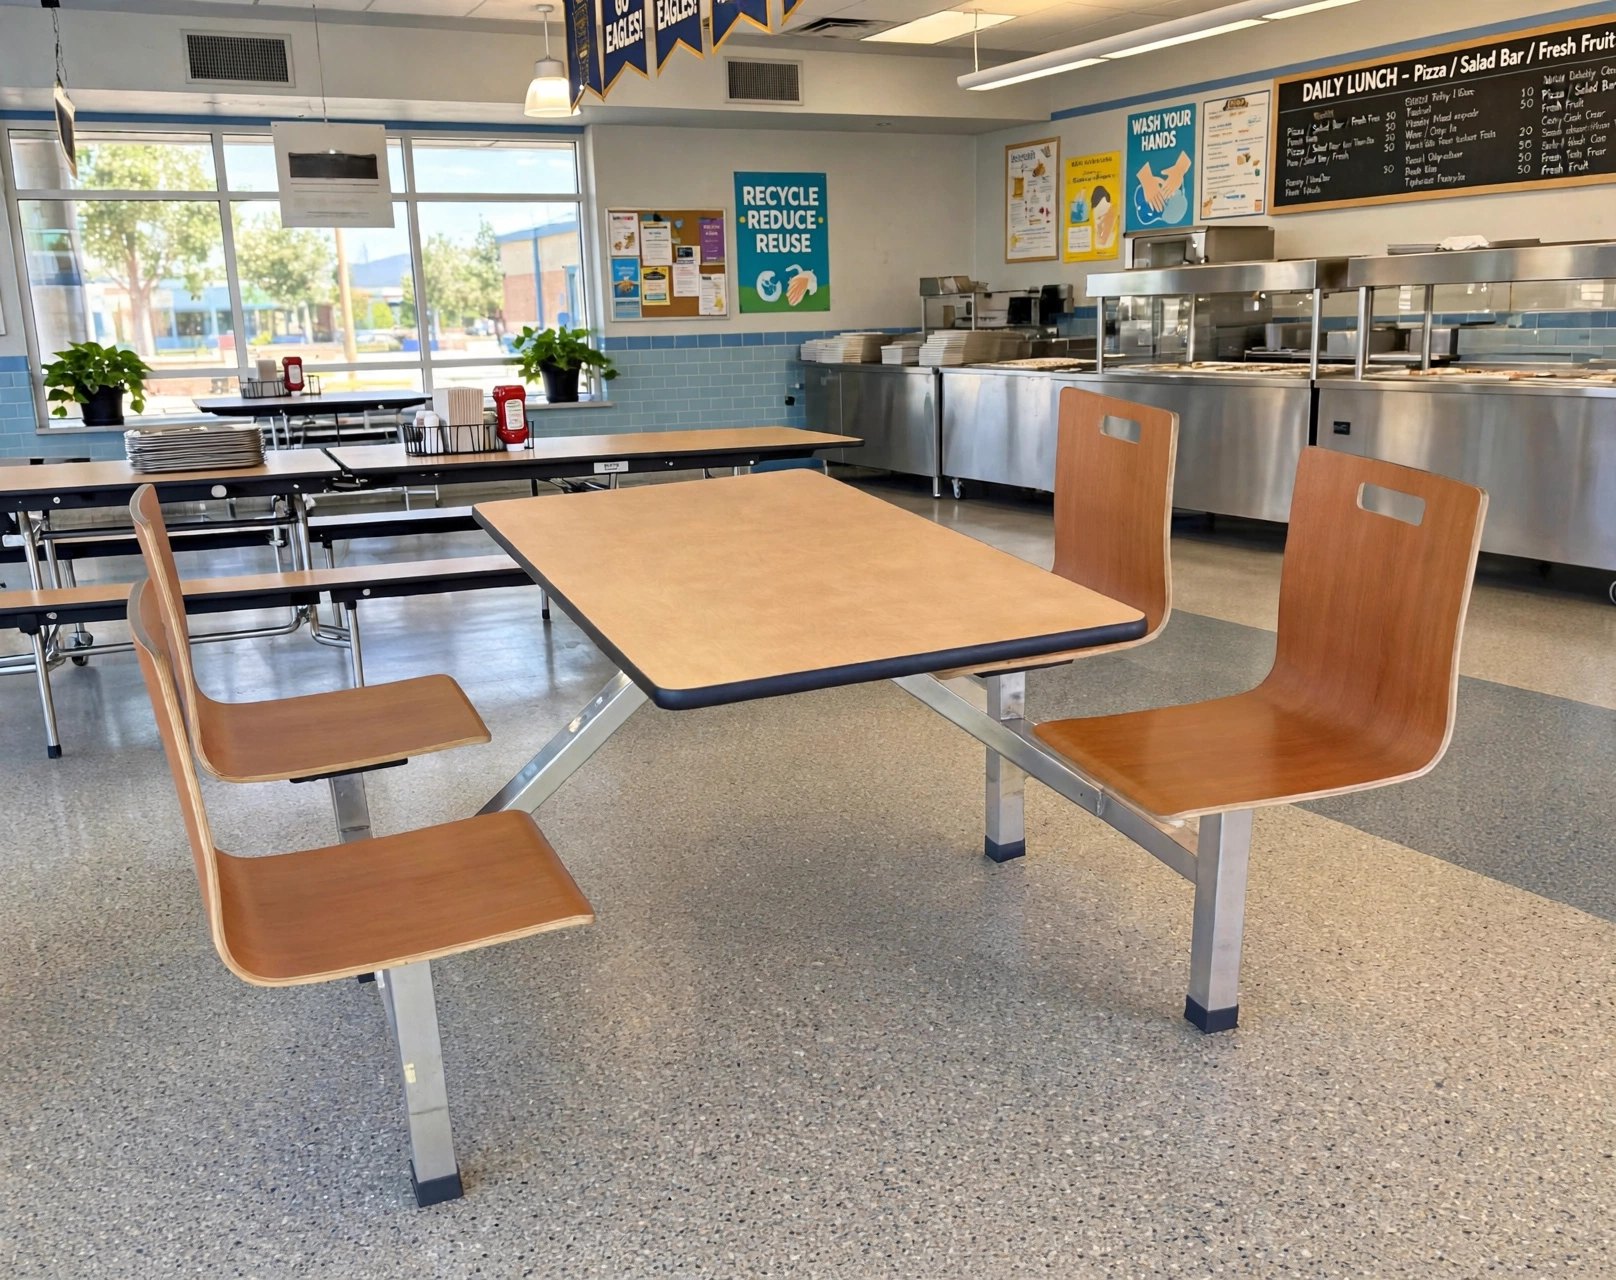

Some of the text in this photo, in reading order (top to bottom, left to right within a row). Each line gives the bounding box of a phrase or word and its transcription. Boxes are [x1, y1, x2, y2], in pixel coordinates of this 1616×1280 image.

[606, 9, 643, 54] EAGLES!
[1303, 77, 1344, 102] DAILY
[1347, 67, 1398, 94] LUNCH
[1414, 64, 1447, 82] Pizza
[1460, 50, 1496, 74] Salad
[1500, 48, 1525, 67] Bar
[1539, 36, 1577, 60] Fresh
[1581, 31, 1616, 53] Fruit
[1132, 114, 1160, 136] WASH
[1163, 109, 1191, 130] YOUR
[1141, 130, 1177, 152] HANDS
[743, 186, 819, 206] RECYCLE
[747, 210, 817, 230] REDUCE
[756, 233, 812, 253] REUSE
